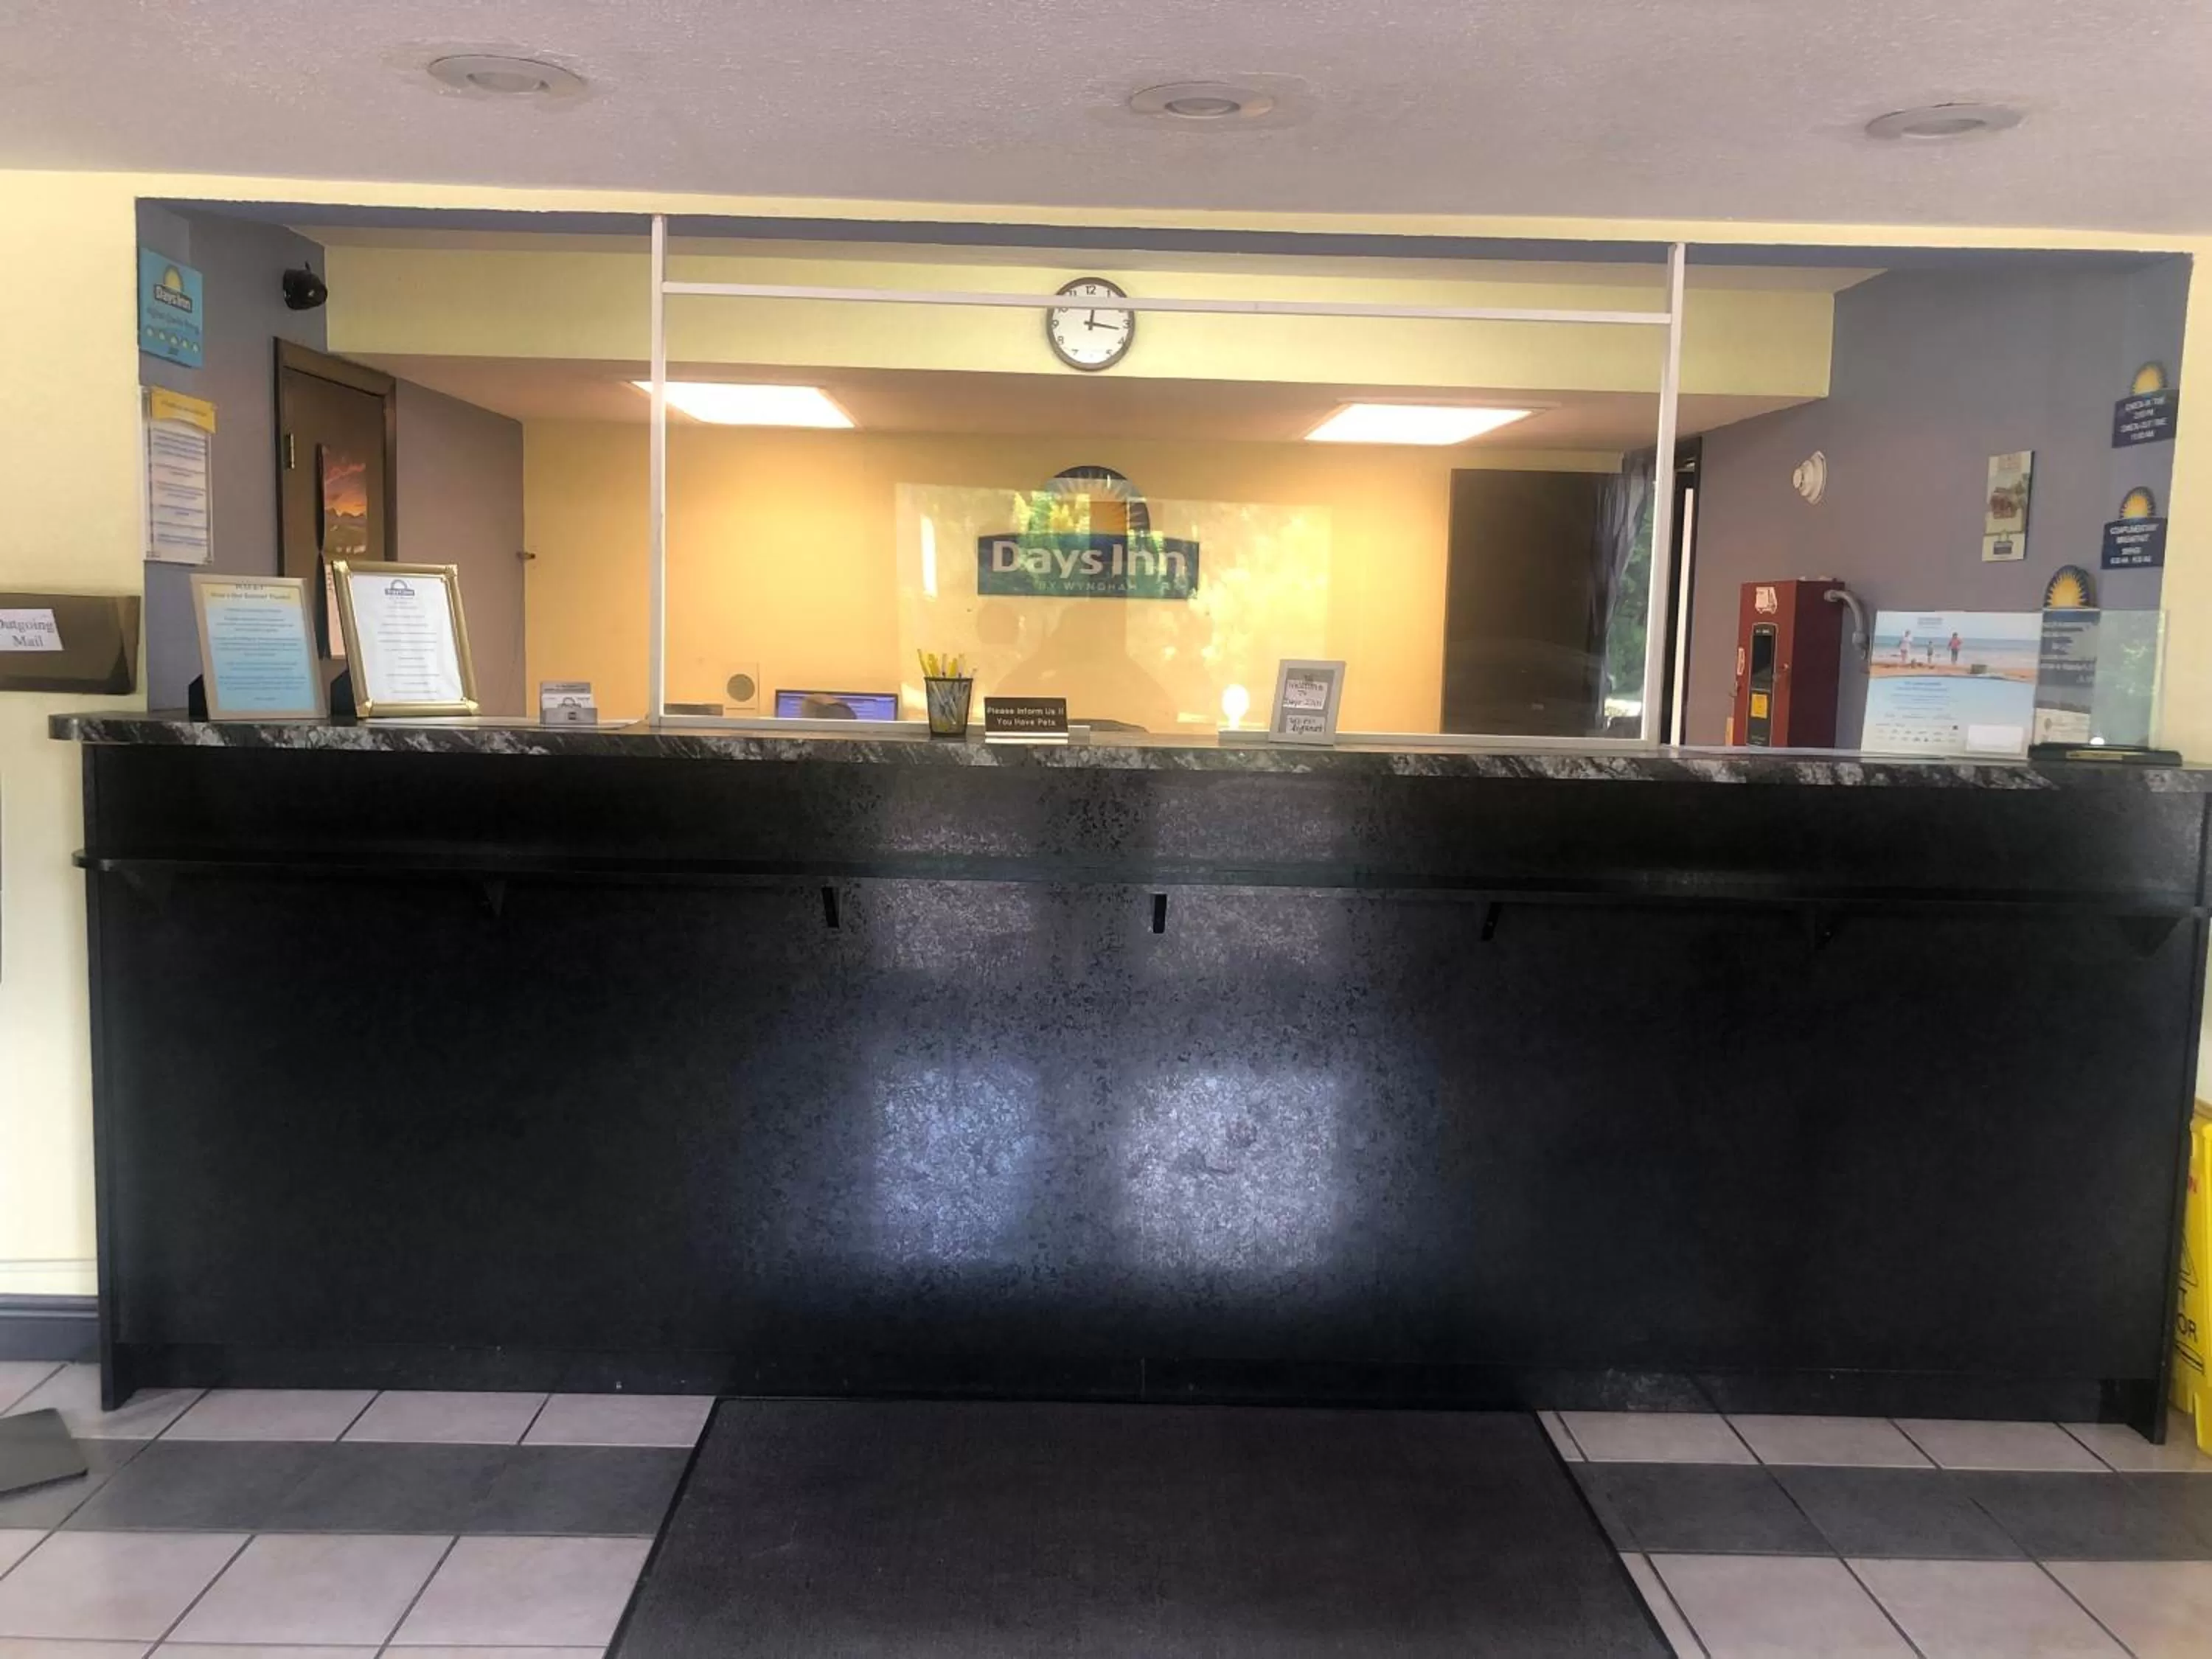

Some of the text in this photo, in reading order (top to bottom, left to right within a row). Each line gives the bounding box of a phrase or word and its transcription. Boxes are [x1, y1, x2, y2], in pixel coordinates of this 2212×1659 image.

[1085, 285, 1096, 295] 12
[992, 540, 1186, 579] Days Inn
[1062, 581, 1138, 591] WYNDHAM
[12, 635, 44, 647] Mail
[987, 707, 1015, 716] Please
[996, 717, 1057, 726] You Have Pets
